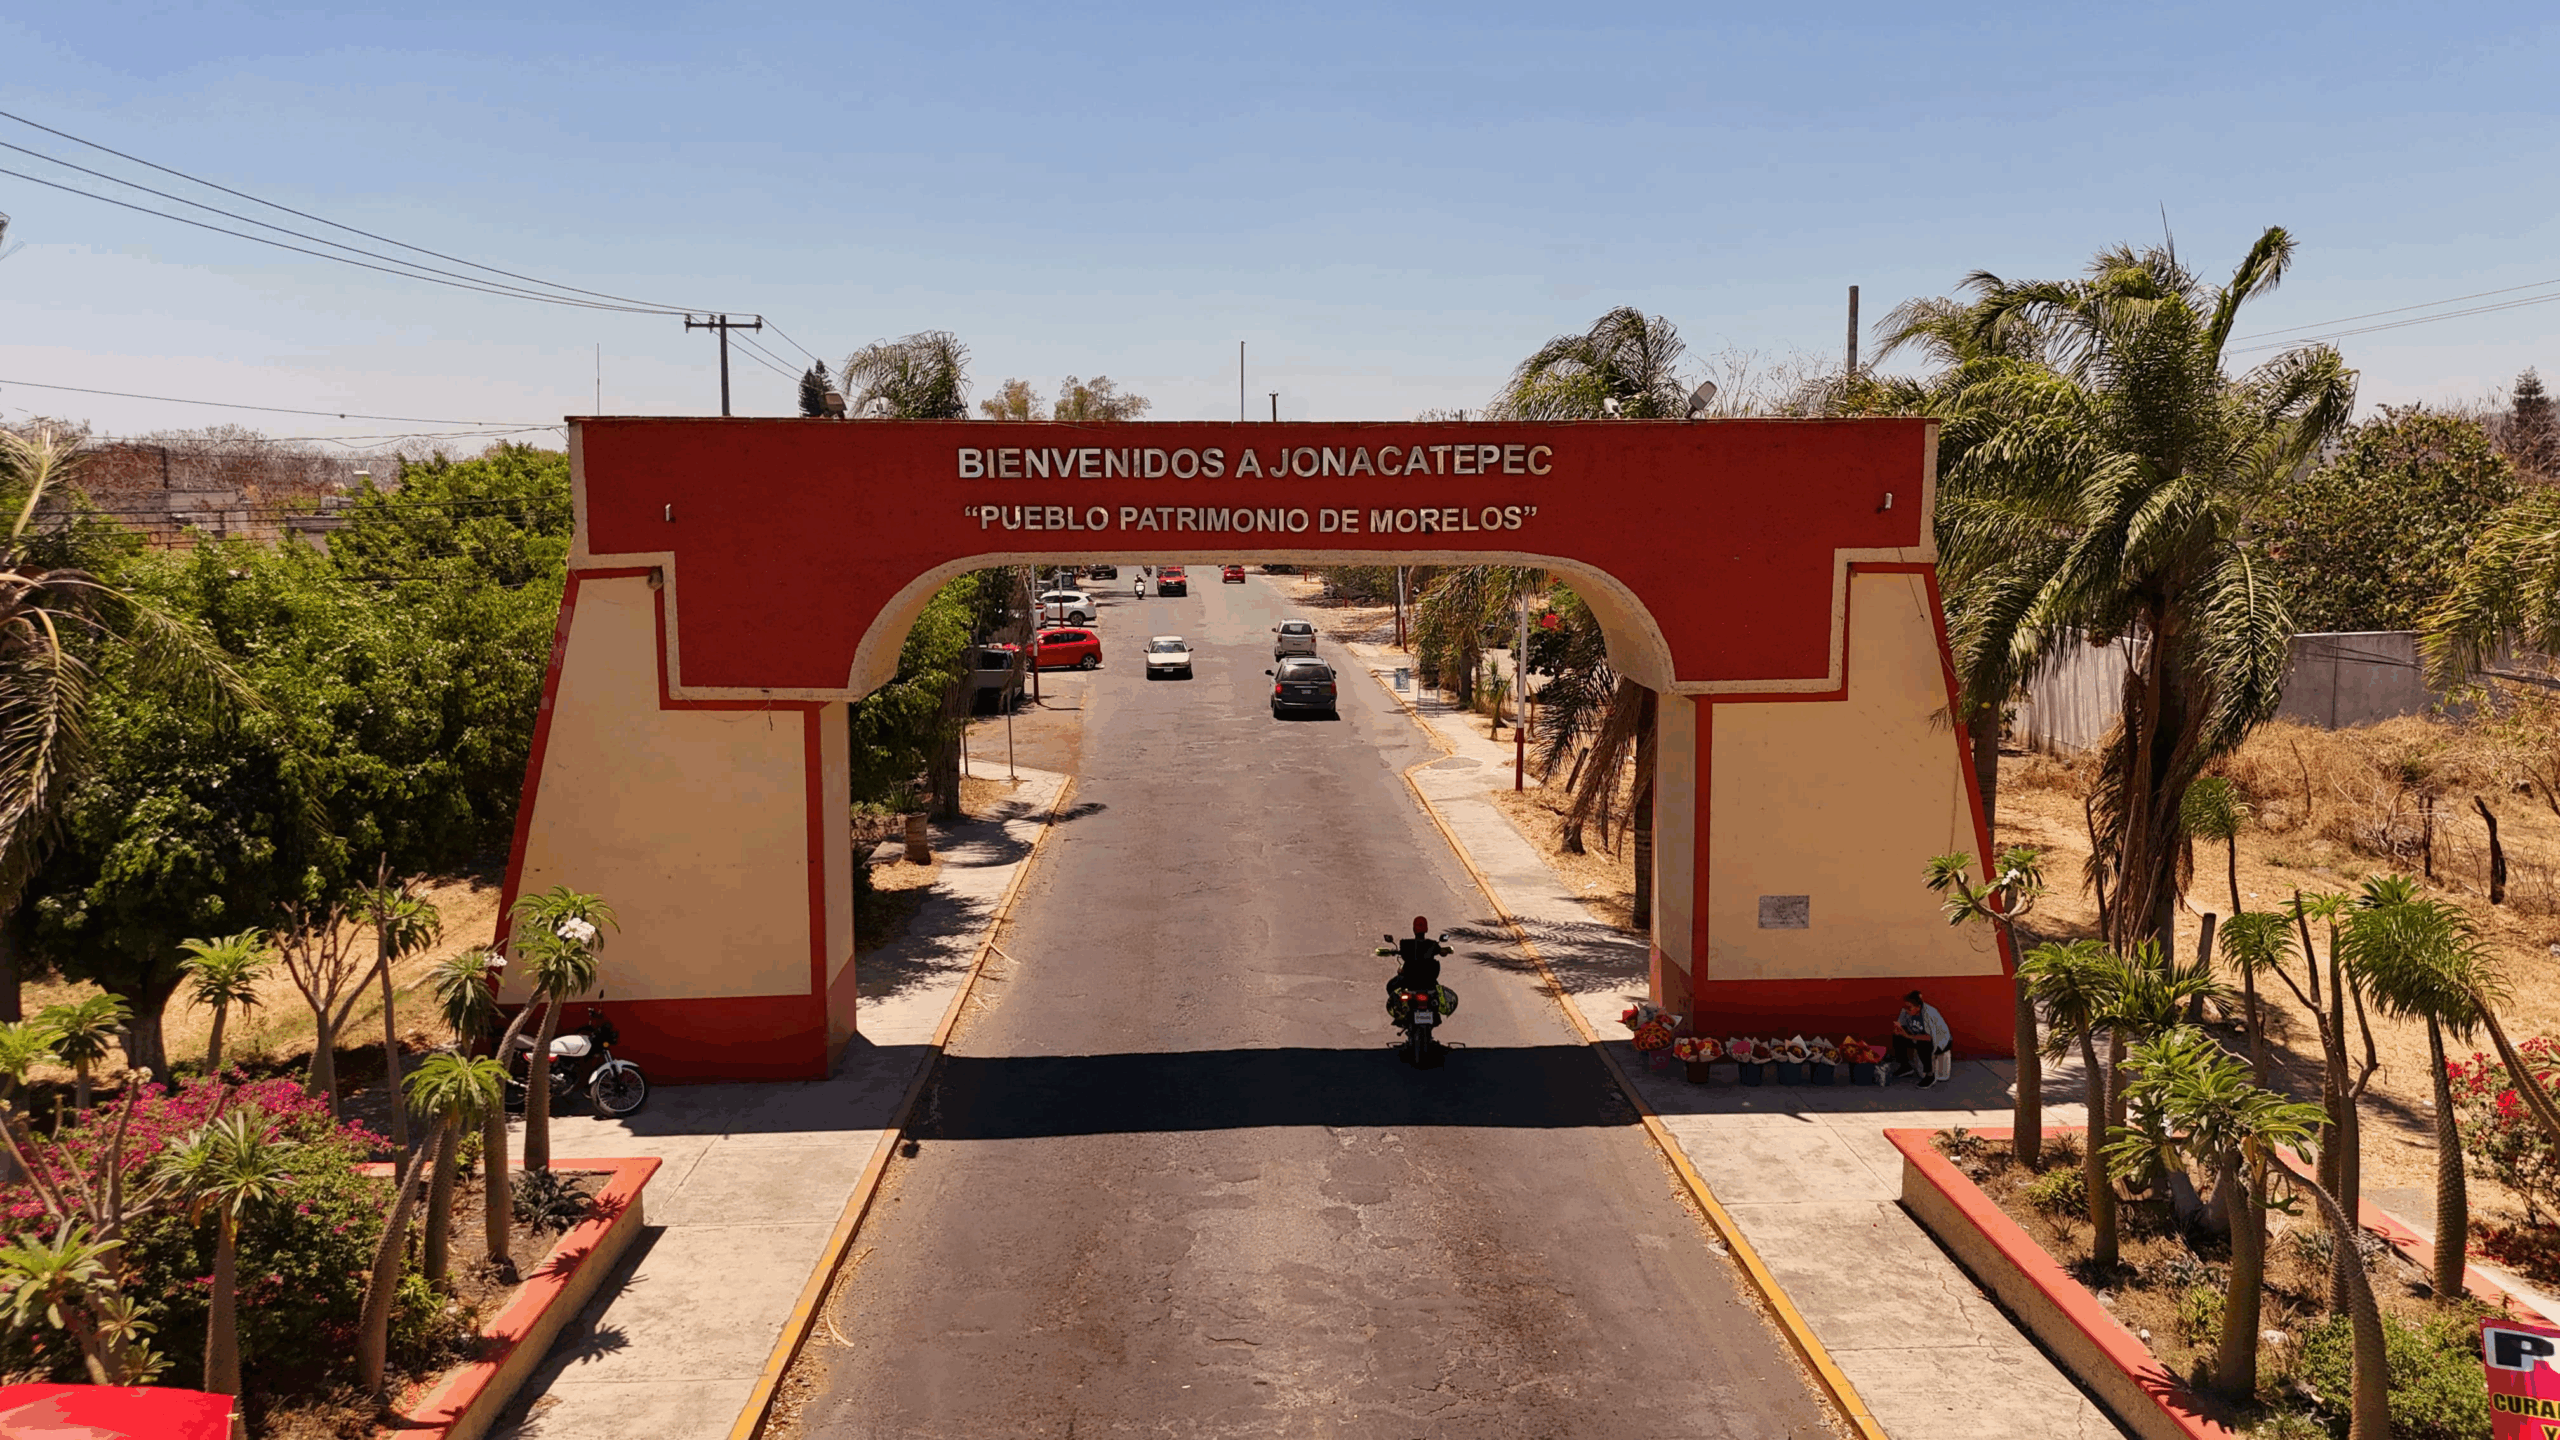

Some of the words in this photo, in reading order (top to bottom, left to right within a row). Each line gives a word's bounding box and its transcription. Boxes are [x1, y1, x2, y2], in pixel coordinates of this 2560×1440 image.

[958, 447, 1225, 479] BIENVENIDOS
[1235, 448, 1264, 479] A
[1269, 444, 1553, 478] JONACATEPEC
[964, 505, 1109, 531] “PUEBLO
[1119, 506, 1309, 533] PATRIMONIO
[1319, 508, 1360, 534] DE
[1370, 505, 1538, 533] MORELOS”
[2492, 1392, 2560, 1420] CURA
